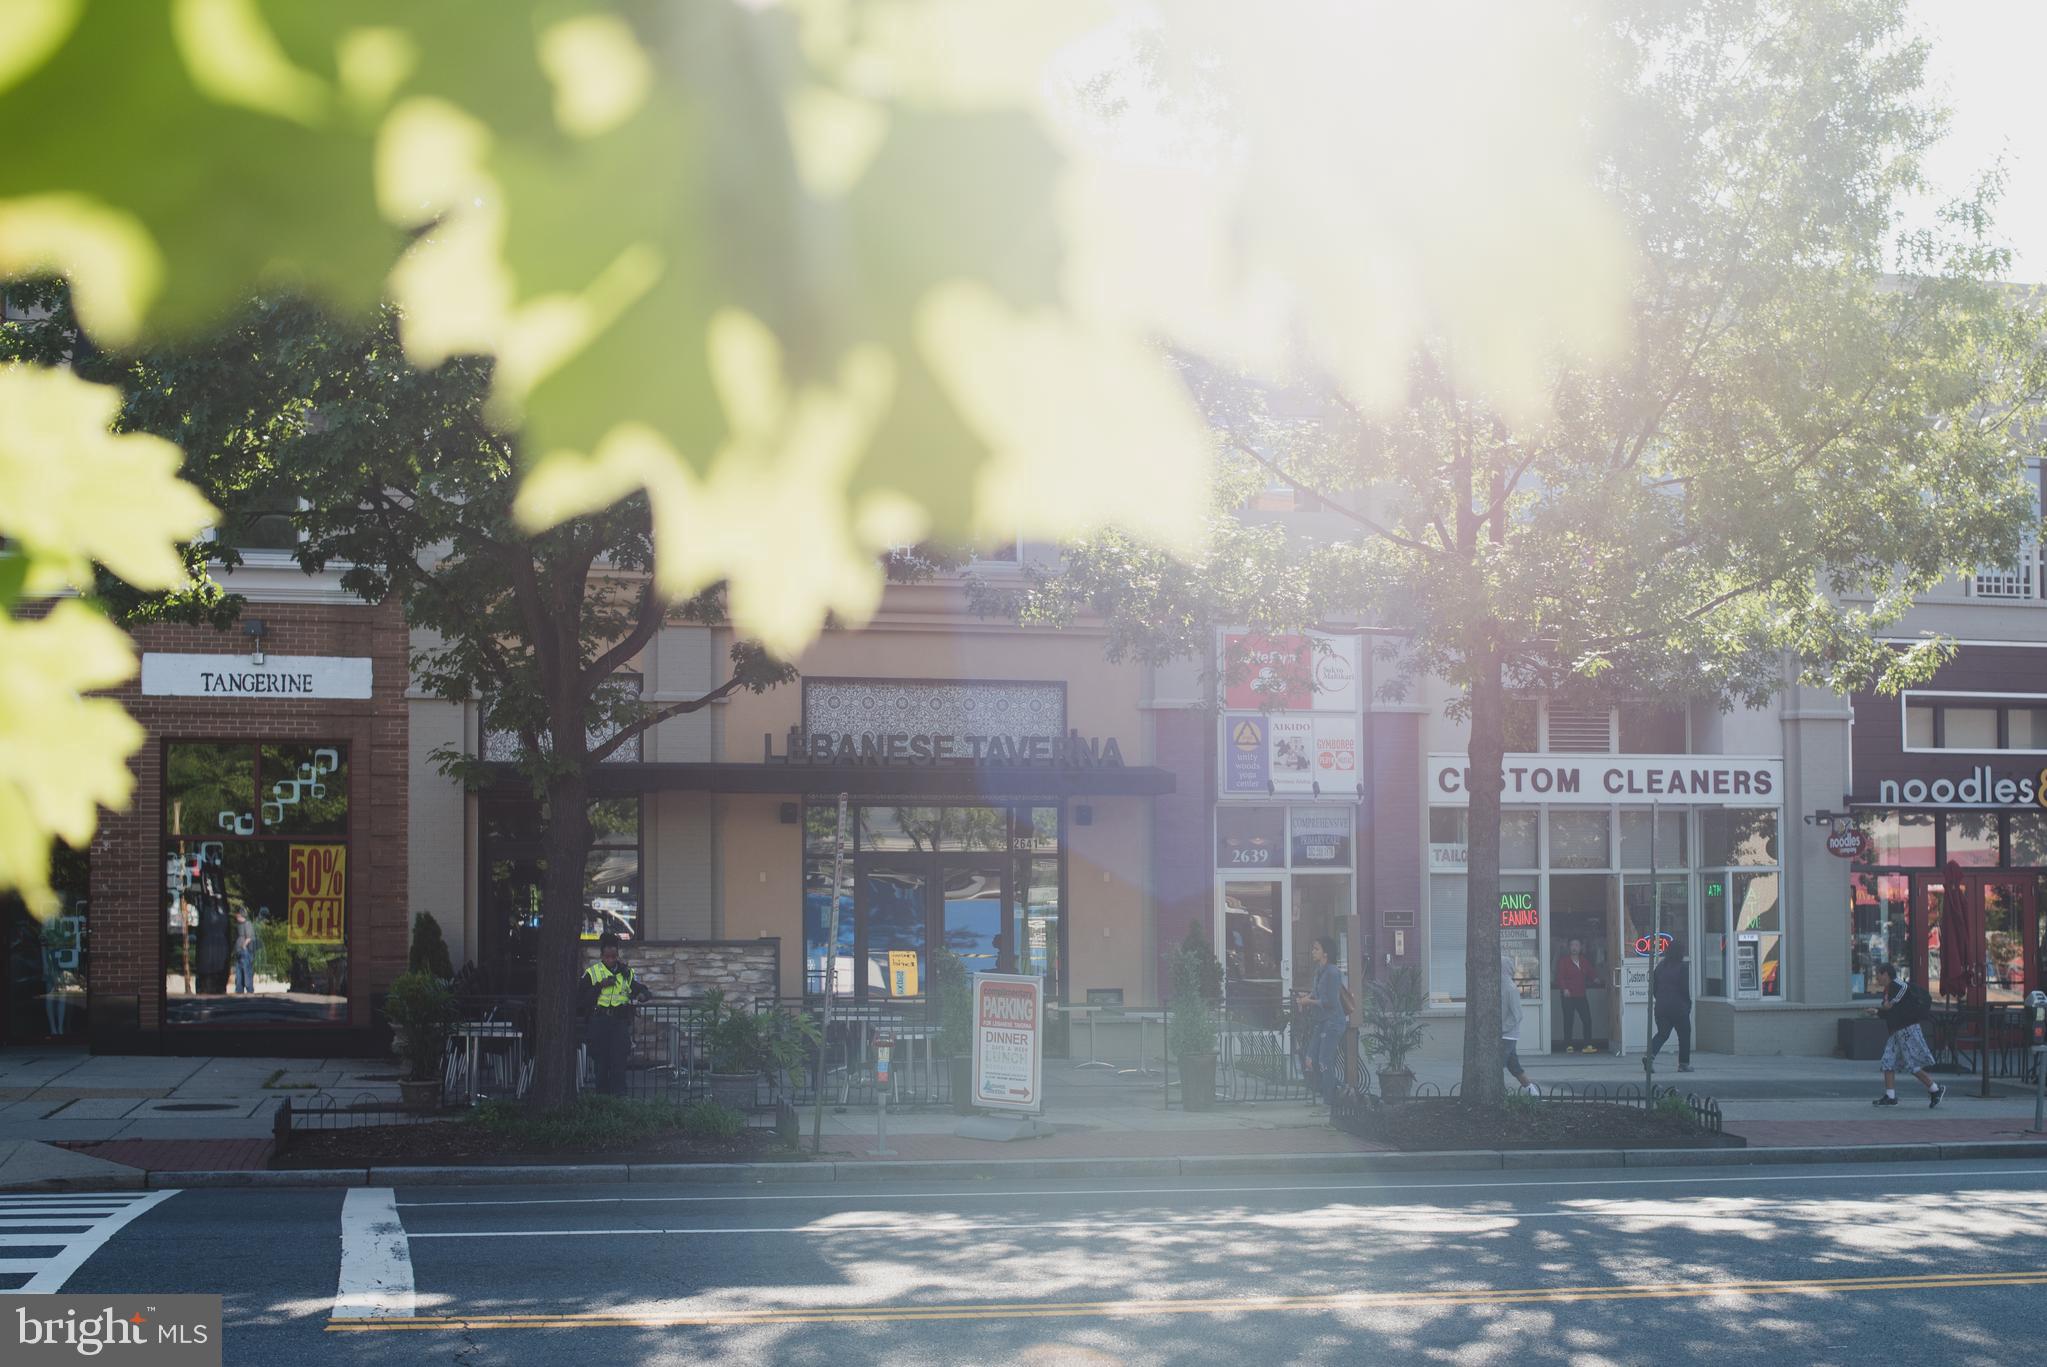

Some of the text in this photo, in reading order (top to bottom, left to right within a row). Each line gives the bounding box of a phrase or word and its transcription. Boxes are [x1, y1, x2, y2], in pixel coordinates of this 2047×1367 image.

[201, 673, 313, 692] TANGERINE
[1273, 722, 1311, 731] AIKIDO
[765, 732, 1125, 767] LEBANESE TAVERNA
[1603, 769, 1772, 795] CLEANERS
[1880, 766, 2035, 805] noodles
[1014, 839, 1039, 849] 2641
[1829, 833, 1861, 848] noodles
[1232, 849, 1269, 862] 2639
[290, 848, 342, 896] 50%
[291, 901, 340, 938] Off!
[1500, 910, 1538, 926] EANING
[984, 996, 1033, 1020] PARKING
[986, 1031, 1029, 1045] DINNER
